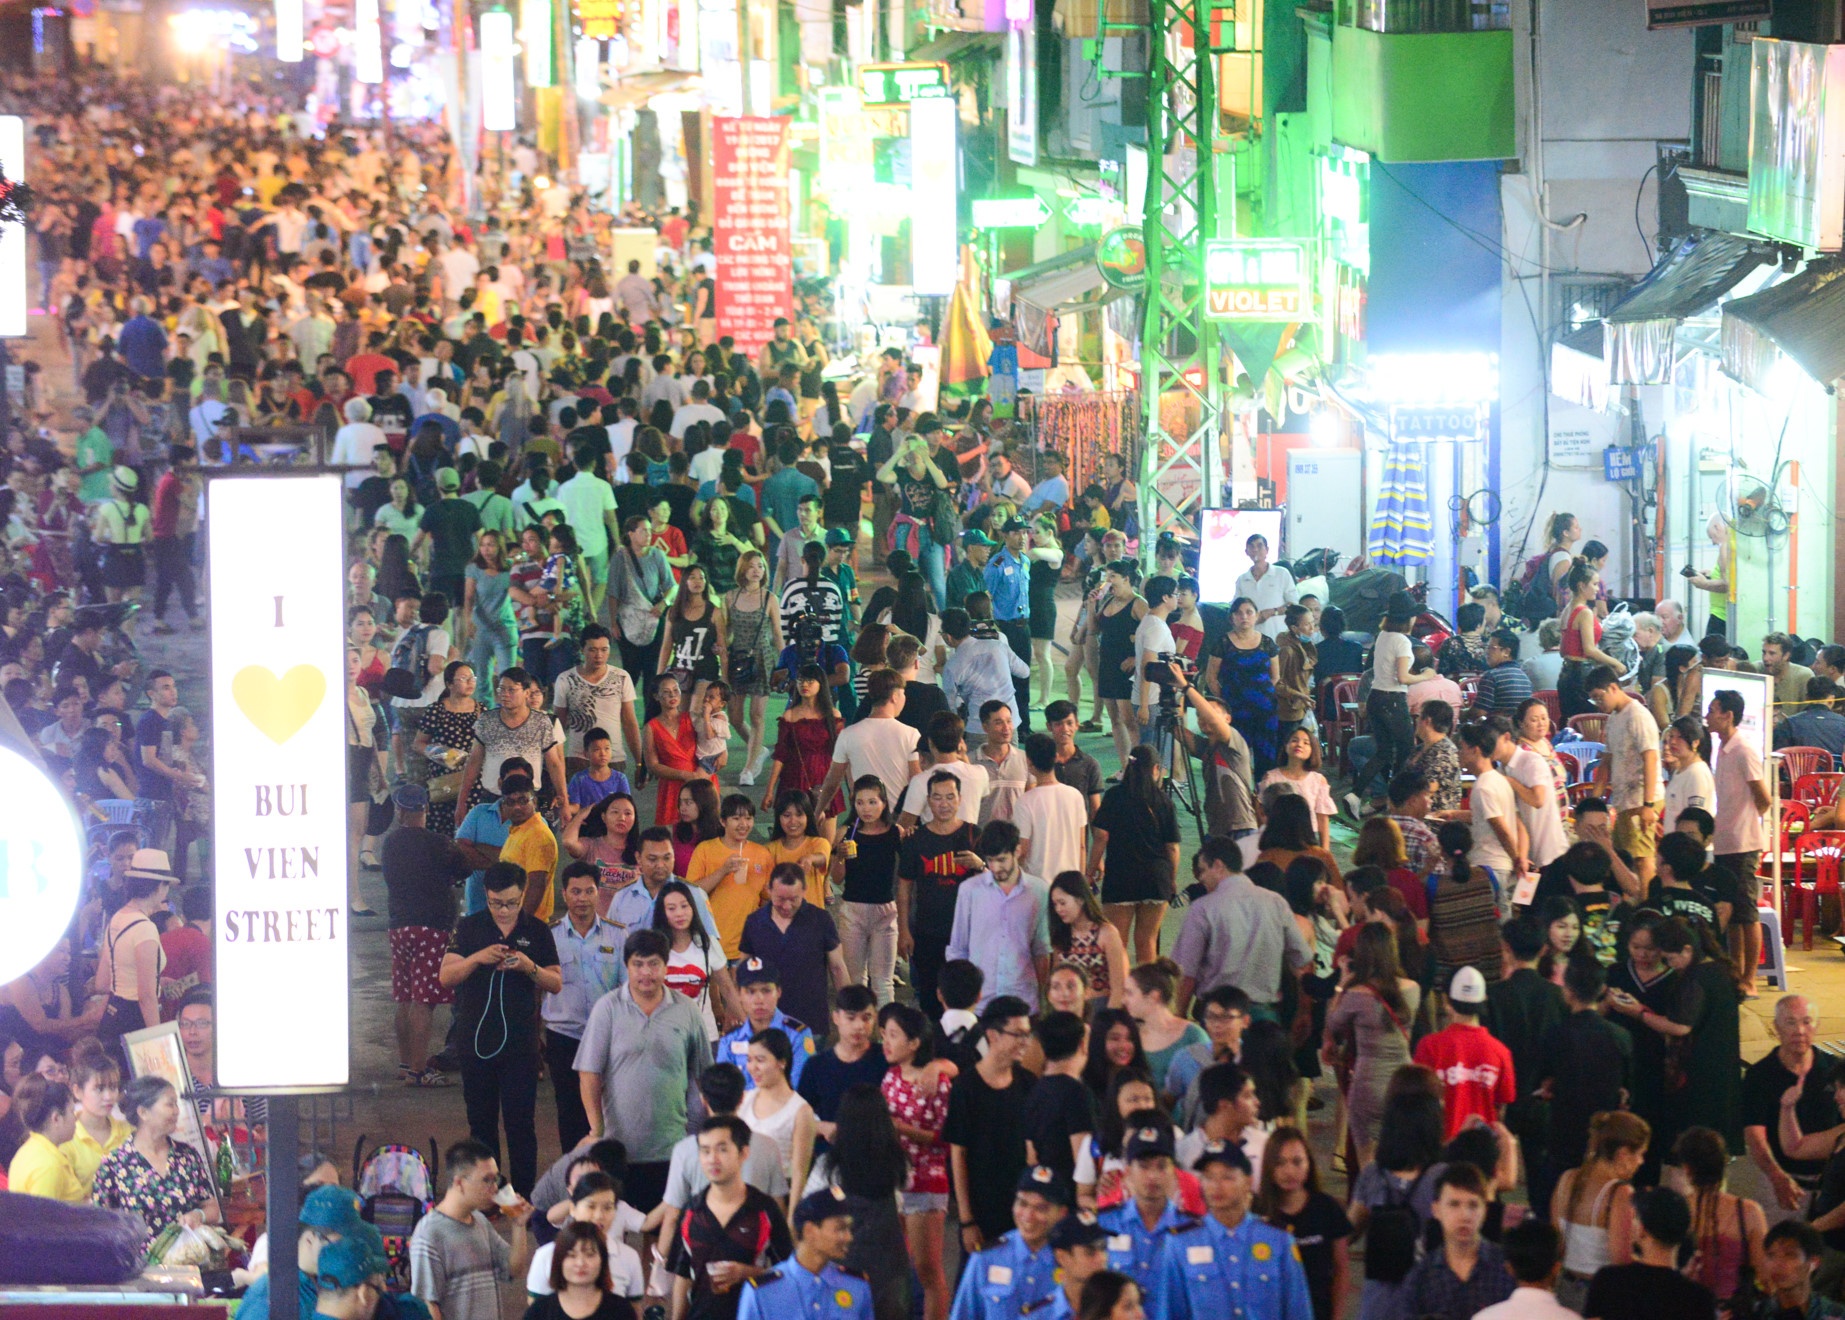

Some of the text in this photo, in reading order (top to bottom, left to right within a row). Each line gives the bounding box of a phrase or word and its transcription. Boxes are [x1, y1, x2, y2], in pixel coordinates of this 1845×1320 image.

[1211, 291, 1298, 311] VIOLET
[1397, 415, 1475, 429] TATTOO
[273, 595, 284, 628] I
[255, 784, 308, 816] BUI
[245, 846, 319, 880] VIEN
[225, 908, 340, 943] STREET
